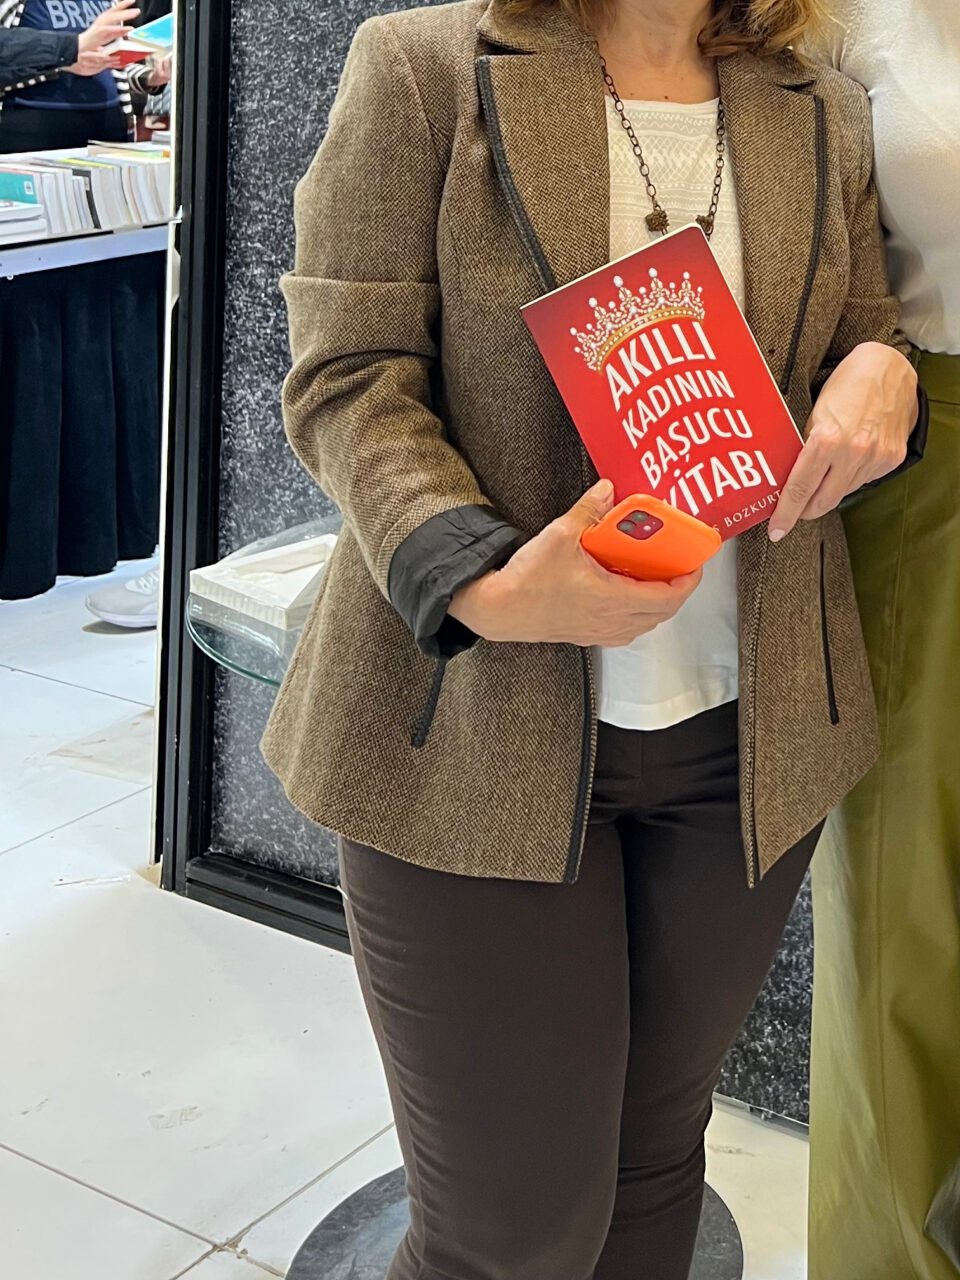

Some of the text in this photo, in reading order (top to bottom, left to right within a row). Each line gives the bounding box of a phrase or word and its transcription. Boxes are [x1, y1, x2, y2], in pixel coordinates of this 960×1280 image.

[605, 321, 717, 412] AKILLI
[621, 370, 735, 449] KADININ
[640, 407, 753, 490] BAŞUCU
[724, 490, 781, 528] BOZKURT
